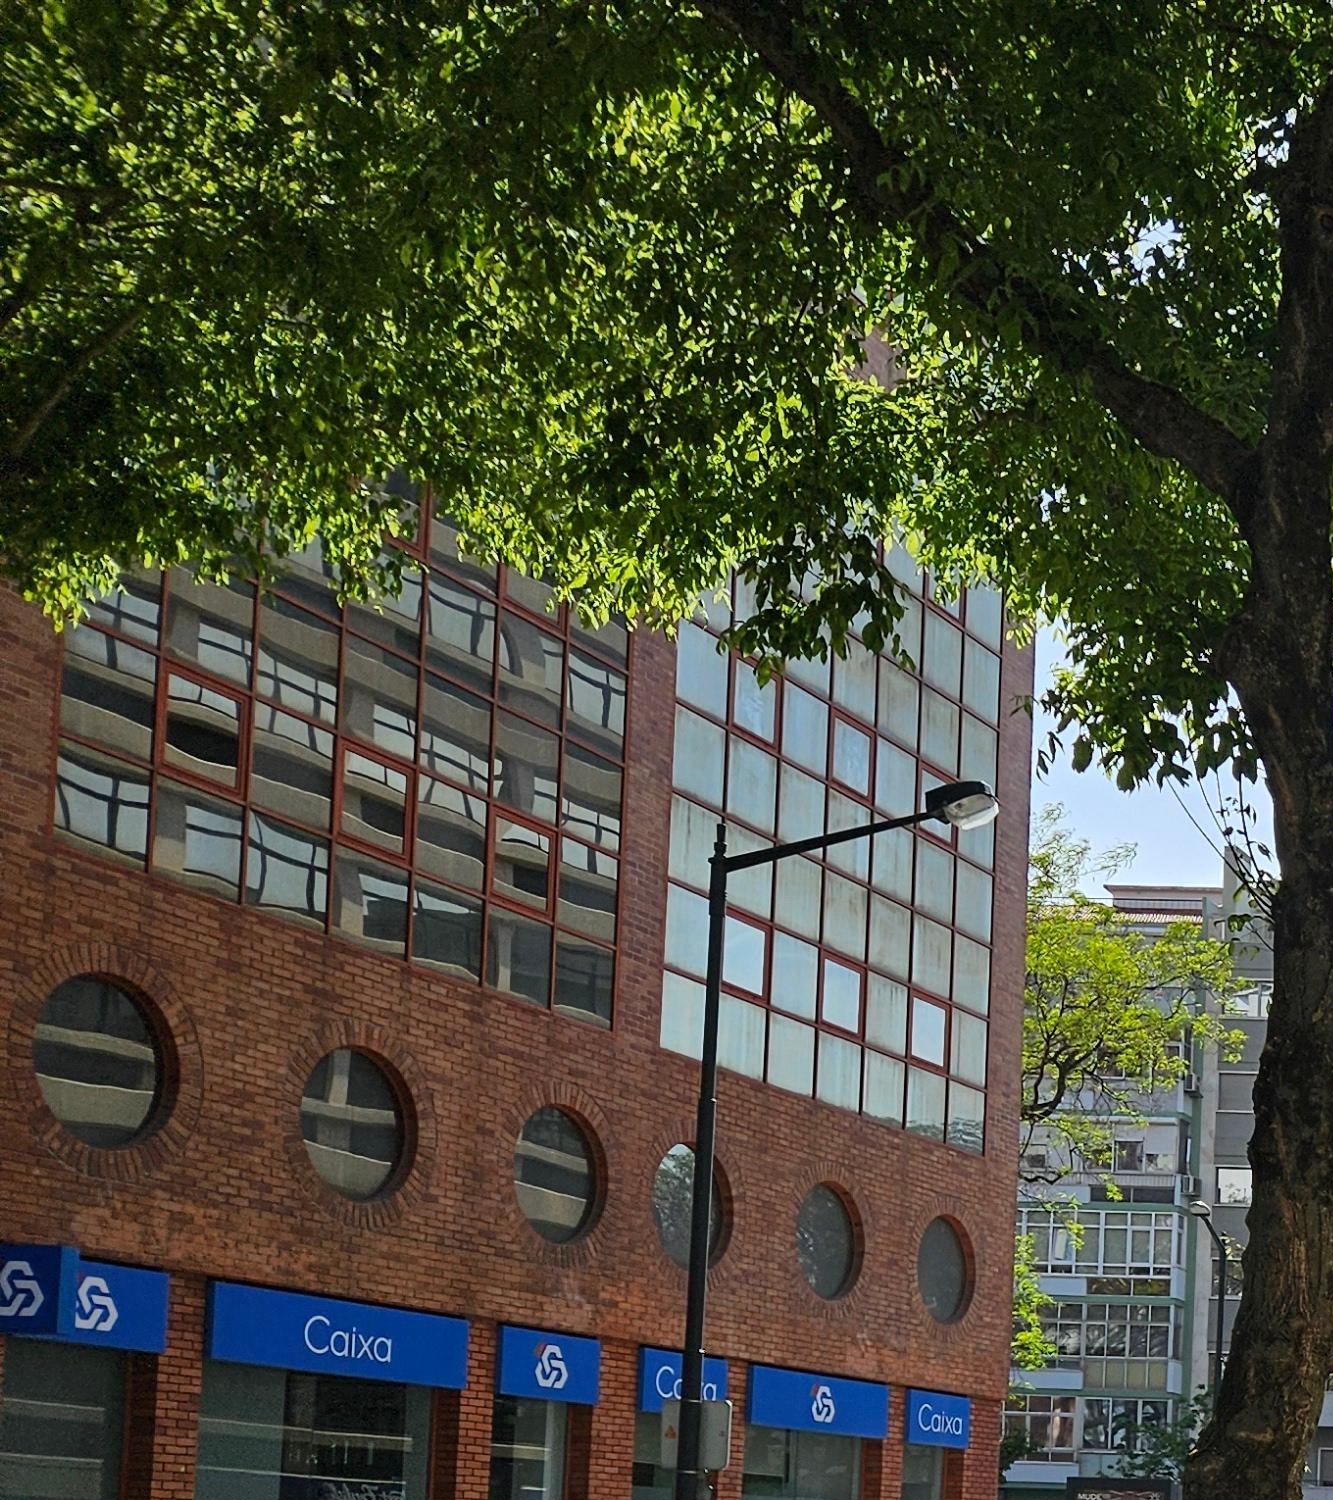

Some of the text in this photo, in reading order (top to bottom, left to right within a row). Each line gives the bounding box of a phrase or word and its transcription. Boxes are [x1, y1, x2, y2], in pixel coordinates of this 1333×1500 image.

[304, 1315, 392, 1363] Caixa
[656, 1366, 717, 1401] Caa
[918, 1403, 963, 1435] Caixa
[1077, 1493, 1103, 1500] MUDE
